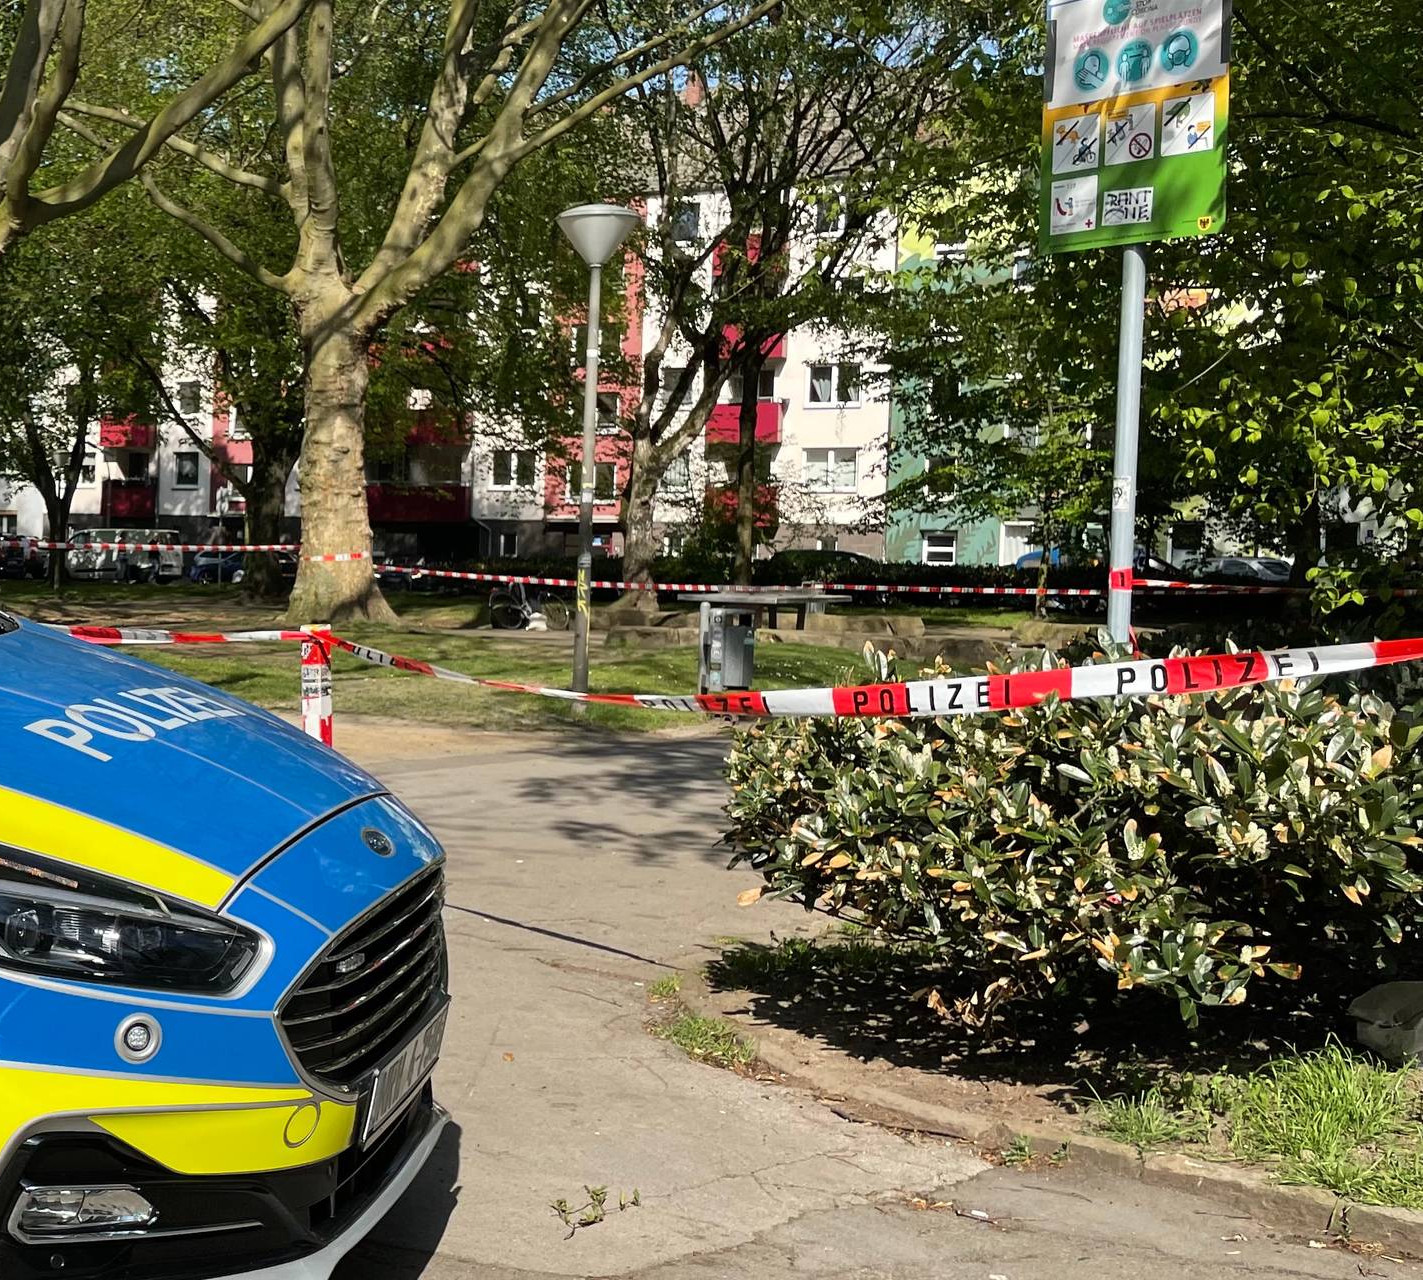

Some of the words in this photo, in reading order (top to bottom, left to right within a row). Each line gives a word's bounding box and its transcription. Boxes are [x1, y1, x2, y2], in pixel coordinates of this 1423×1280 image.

[1117, 651, 1319, 695] POLIZEI
[853, 678, 1011, 715] POLIZEI
[23, 687, 246, 762] POLIZEI
